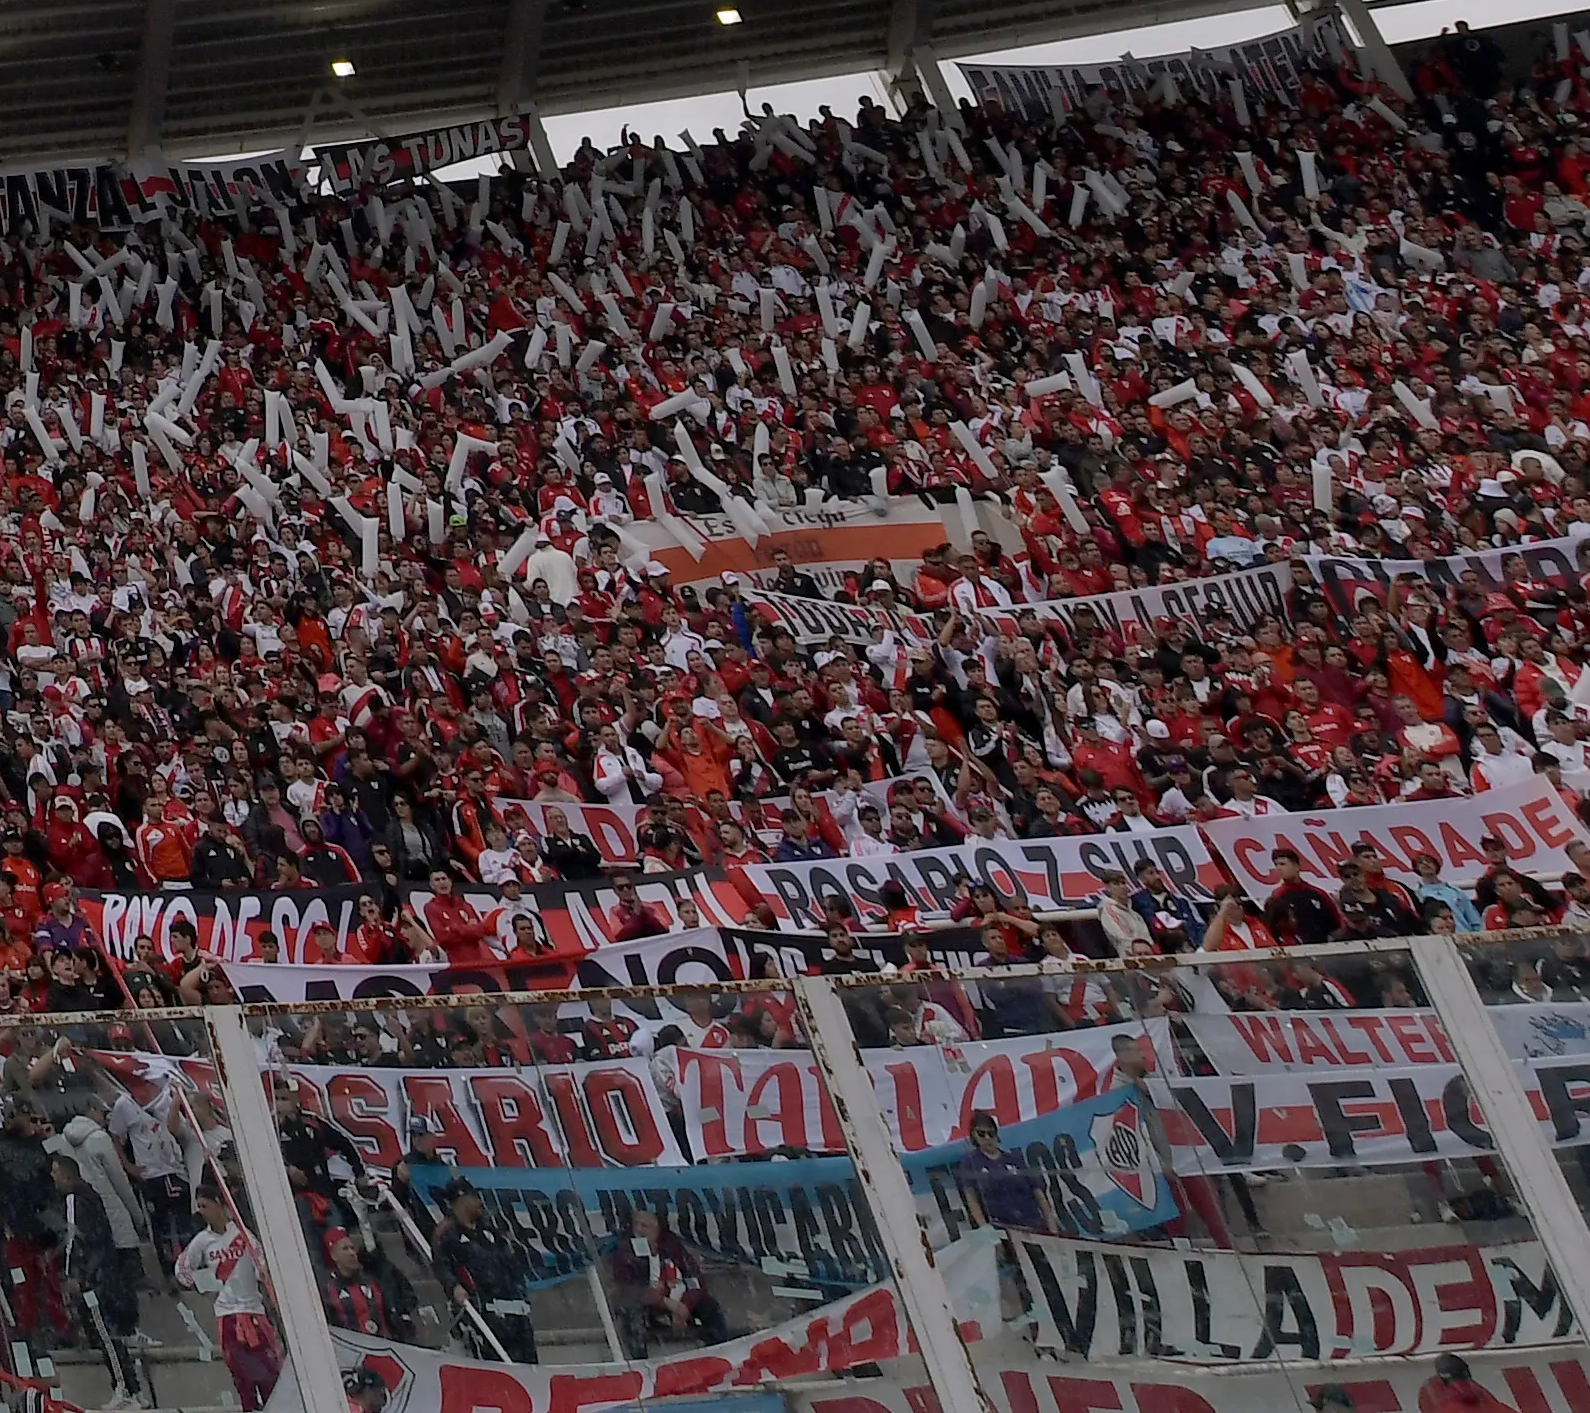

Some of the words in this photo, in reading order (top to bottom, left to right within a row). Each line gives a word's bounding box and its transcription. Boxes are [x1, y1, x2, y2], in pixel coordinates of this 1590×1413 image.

[401, 116, 525, 173] TUNAS
[776, 847, 1018, 928] ROSARIO
[1087, 834, 1197, 900] SUR
[1234, 817, 1490, 886] CAÑADA
[675, 1034, 1156, 1157] TALAD
[1021, 1241, 1320, 1361] VILLA
[1339, 1258, 1483, 1355] DE
